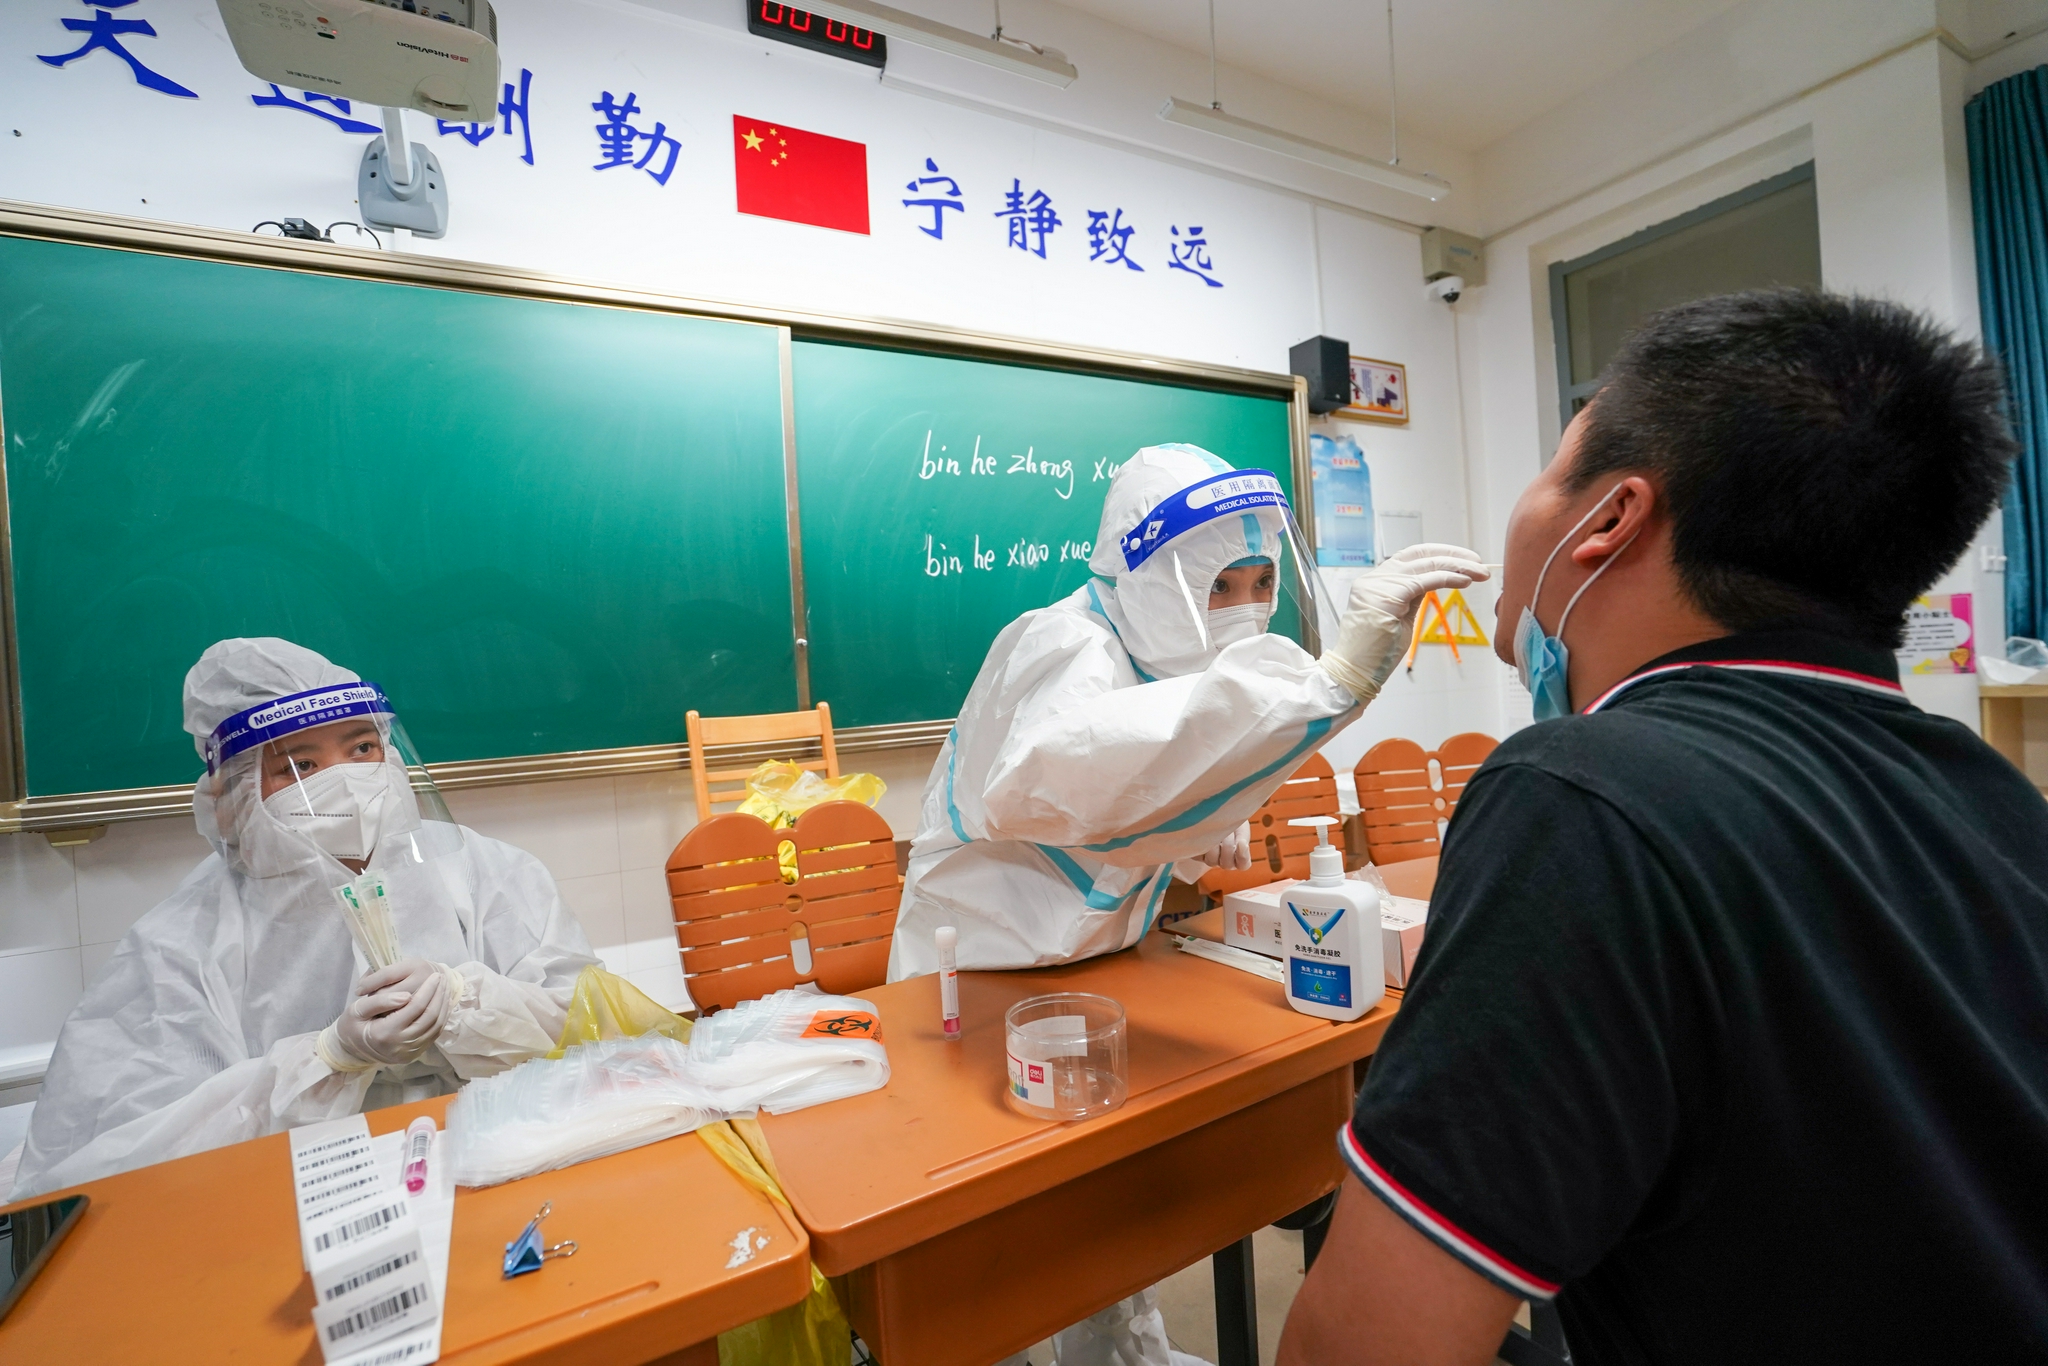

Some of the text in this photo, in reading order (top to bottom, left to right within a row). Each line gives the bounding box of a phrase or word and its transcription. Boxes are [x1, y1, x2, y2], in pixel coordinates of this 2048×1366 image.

[396, 41, 449, 58] HiteVision
[902, 157, 1223, 288] 宁静致远
[918, 430, 961, 480] bin
[971, 435, 998, 476] he
[1093, 456, 1118, 482] xu
[1214, 497, 1248, 513] MEDICAL
[925, 535, 1092, 577] bin he xiao xue
[253, 701, 306, 726] Medical
[309, 695, 341, 709] Face
[344, 689, 375, 702] Shield
[298, 706, 352, 726] 医用隔离面罩
[1294, 943, 1341, 958] 免洗手消毒凝胶
